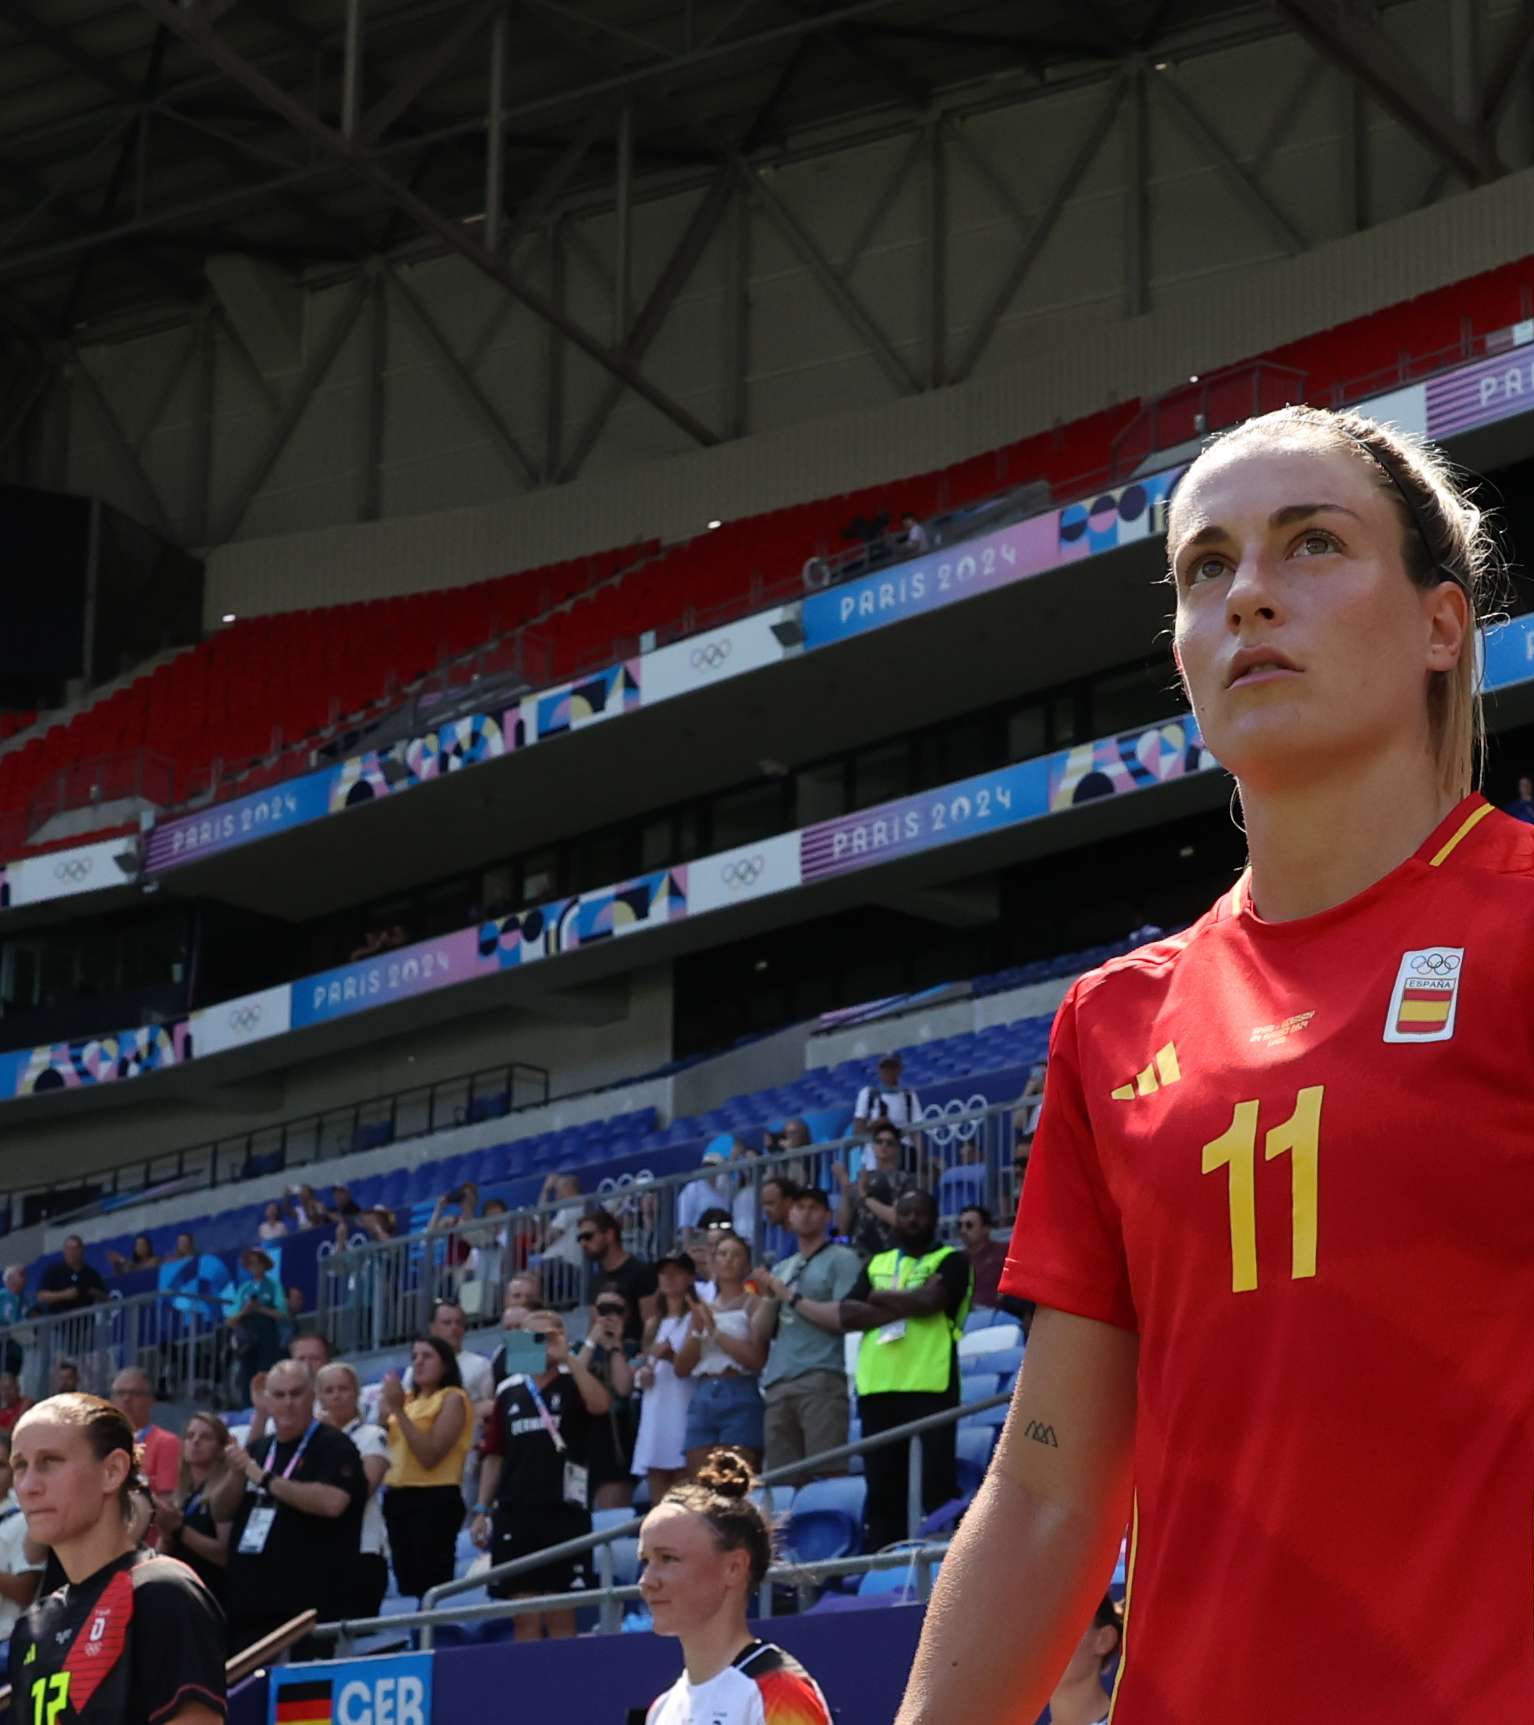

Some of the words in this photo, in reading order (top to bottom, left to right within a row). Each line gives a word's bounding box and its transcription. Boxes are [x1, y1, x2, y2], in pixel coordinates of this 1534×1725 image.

[938, 544, 1016, 591] 2024
[241, 794, 297, 832] 2024
[932, 786, 1011, 831] 2024
[388, 953, 449, 988] 2024
[1408, 978, 1451, 988] ESPAÑA
[1202, 1085, 1323, 1293] 11
[337, 1676, 424, 1725] GER
